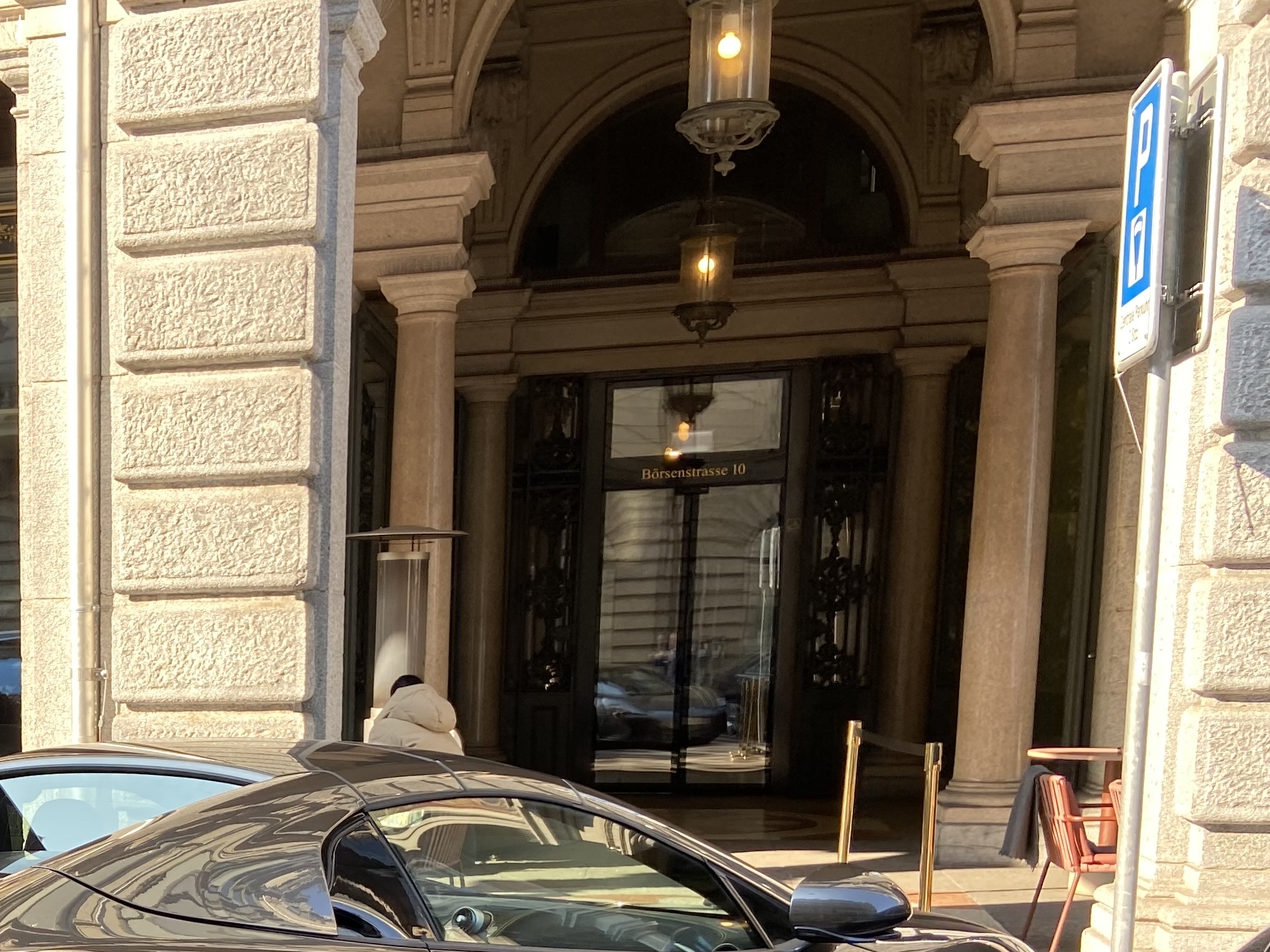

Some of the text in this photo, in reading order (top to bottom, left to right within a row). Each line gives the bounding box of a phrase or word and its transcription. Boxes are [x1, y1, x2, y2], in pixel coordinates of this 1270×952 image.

[1133, 102, 1154, 209] P
[641, 462, 747, 480] Börsenstrasse 10
